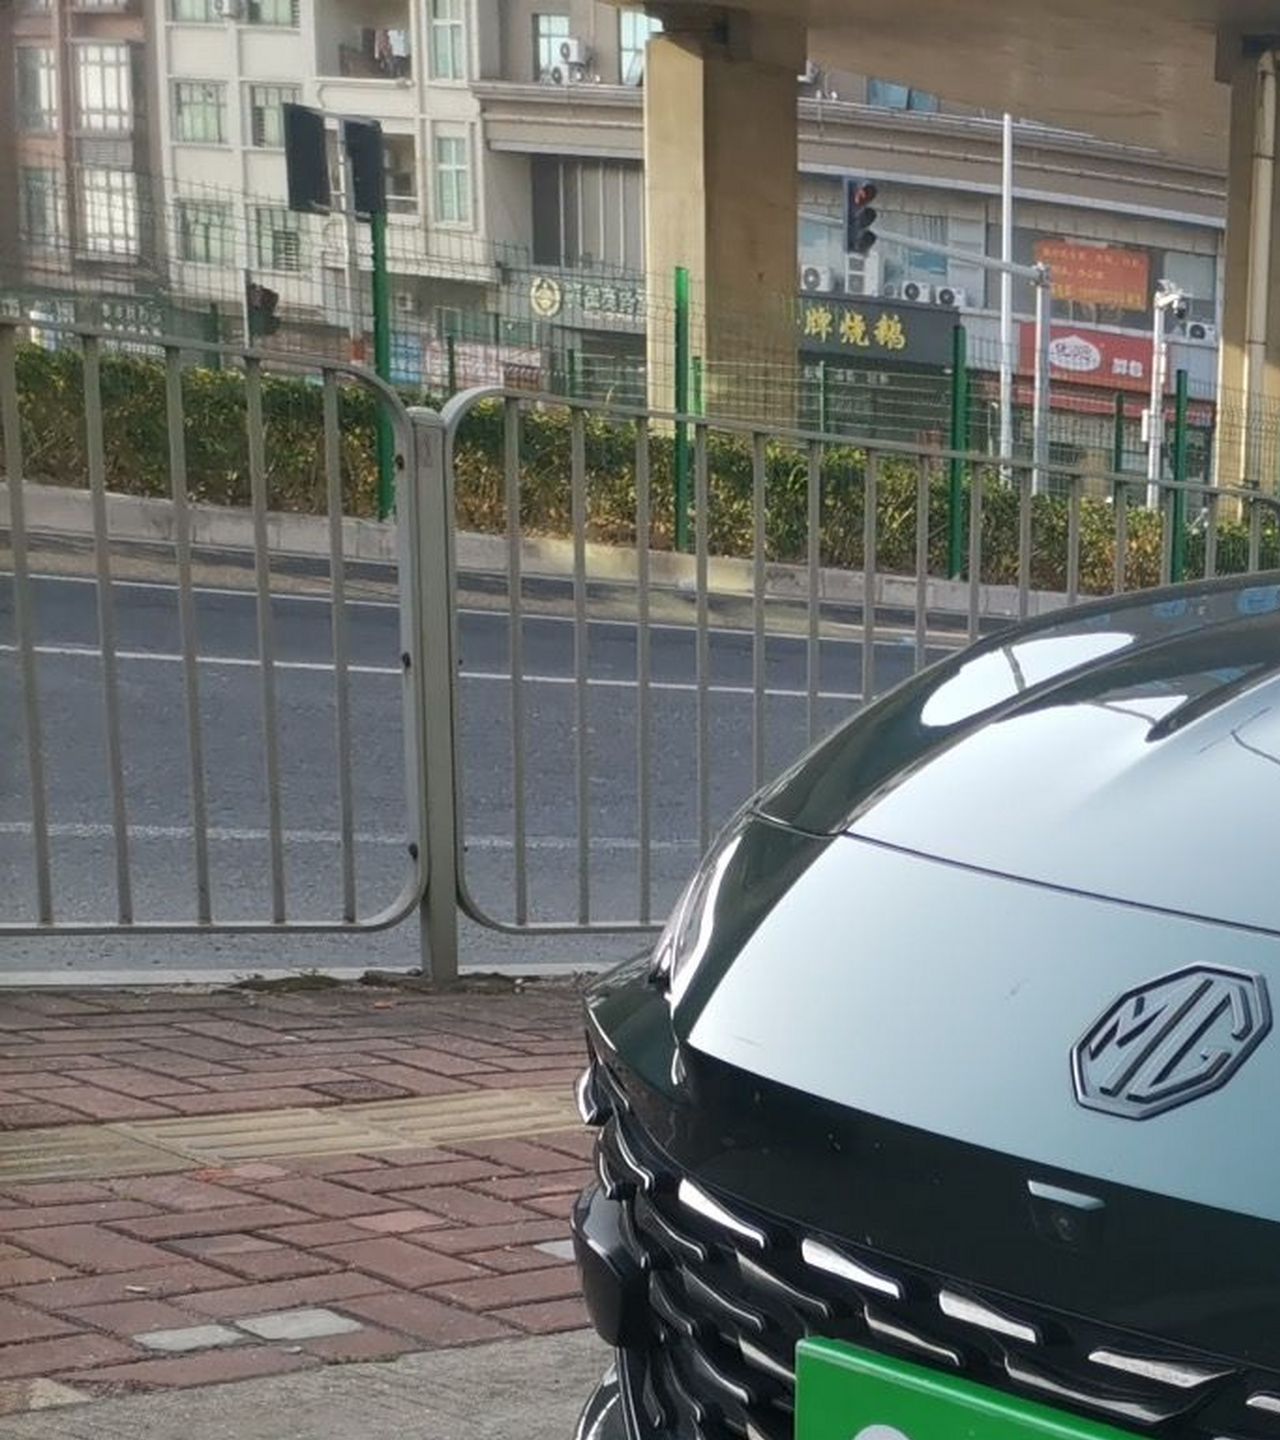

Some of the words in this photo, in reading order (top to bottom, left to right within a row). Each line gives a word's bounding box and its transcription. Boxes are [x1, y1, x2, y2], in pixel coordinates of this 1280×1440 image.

[797, 306, 906, 350] 牌烧鹅
[1086, 973, 1255, 1106] MG
